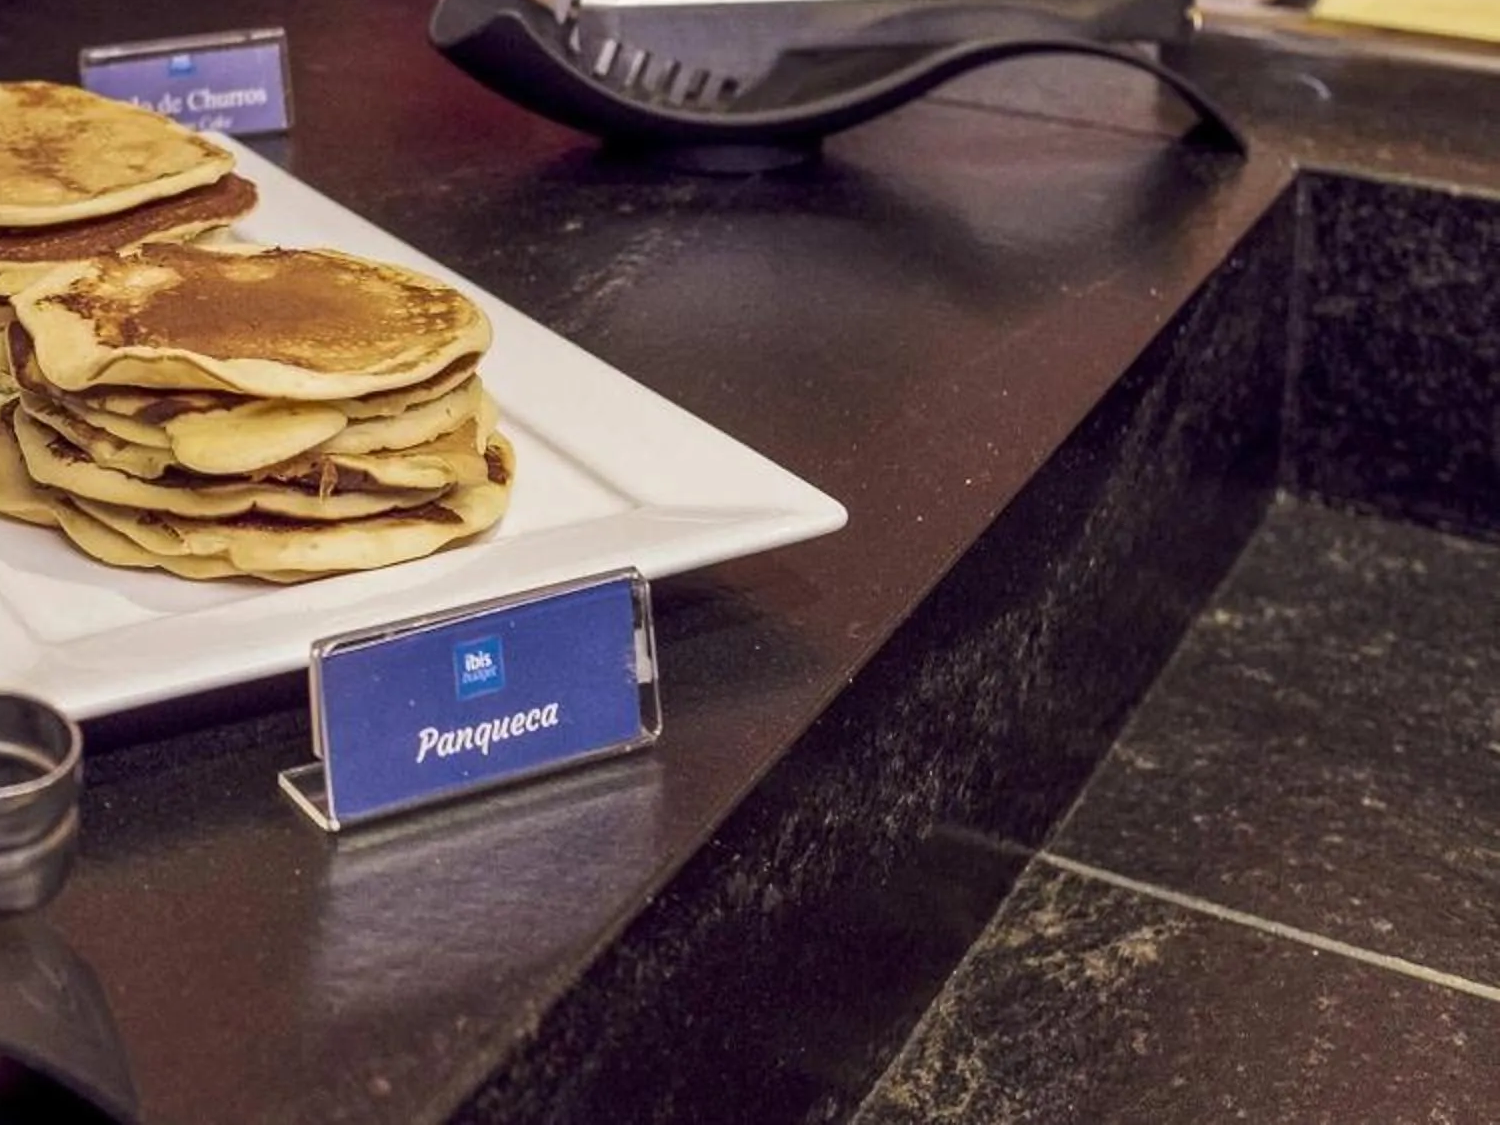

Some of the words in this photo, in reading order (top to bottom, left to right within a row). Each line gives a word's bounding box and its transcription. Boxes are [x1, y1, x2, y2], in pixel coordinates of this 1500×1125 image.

[157, 91, 183, 114] de
[186, 88, 267, 112] Churros
[464, 650, 493, 672] ibis
[416, 702, 559, 763] Panqueca
